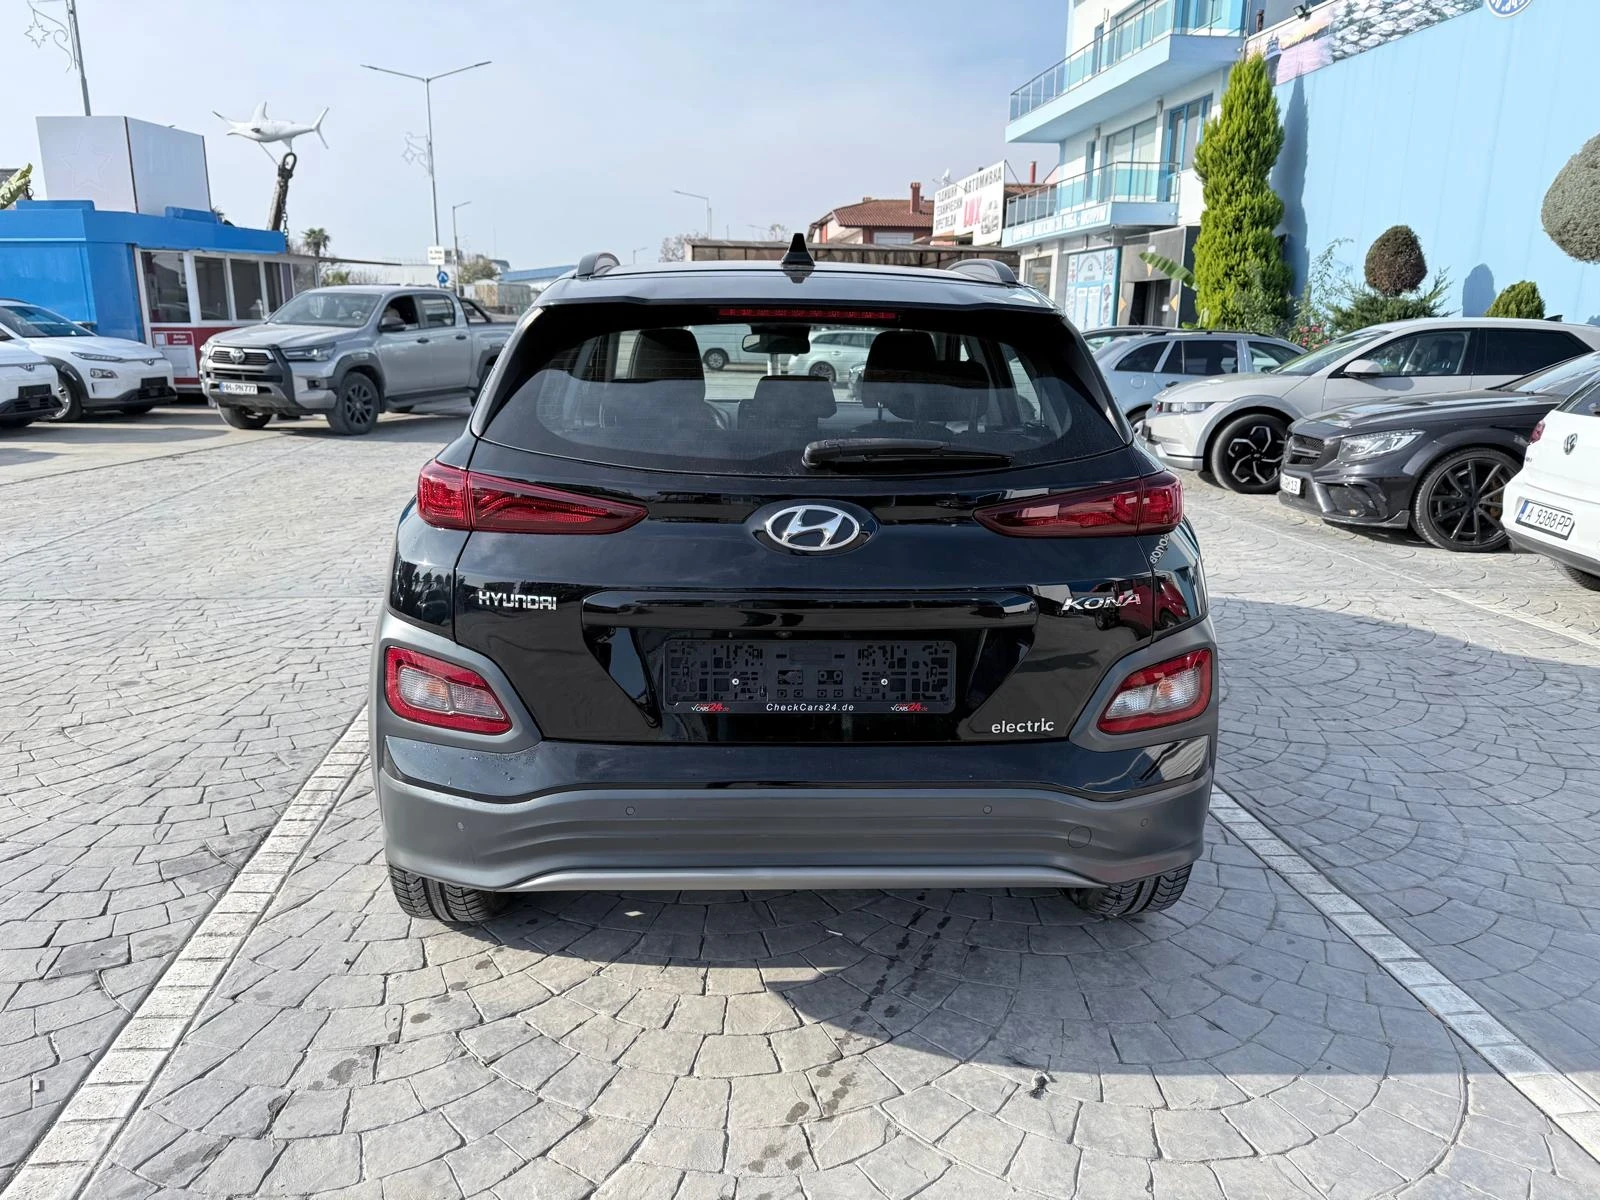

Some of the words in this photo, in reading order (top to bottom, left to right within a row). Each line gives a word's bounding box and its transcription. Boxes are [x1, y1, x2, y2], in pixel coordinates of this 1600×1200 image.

[964, 166, 1002, 194] АВТОМИВКА
[478, 590, 557, 611] HYUNDAI
[1062, 594, 1142, 612] KONA
[765, 703, 855, 712] CheckCars24.de
[991, 718, 1055, 734] electric
